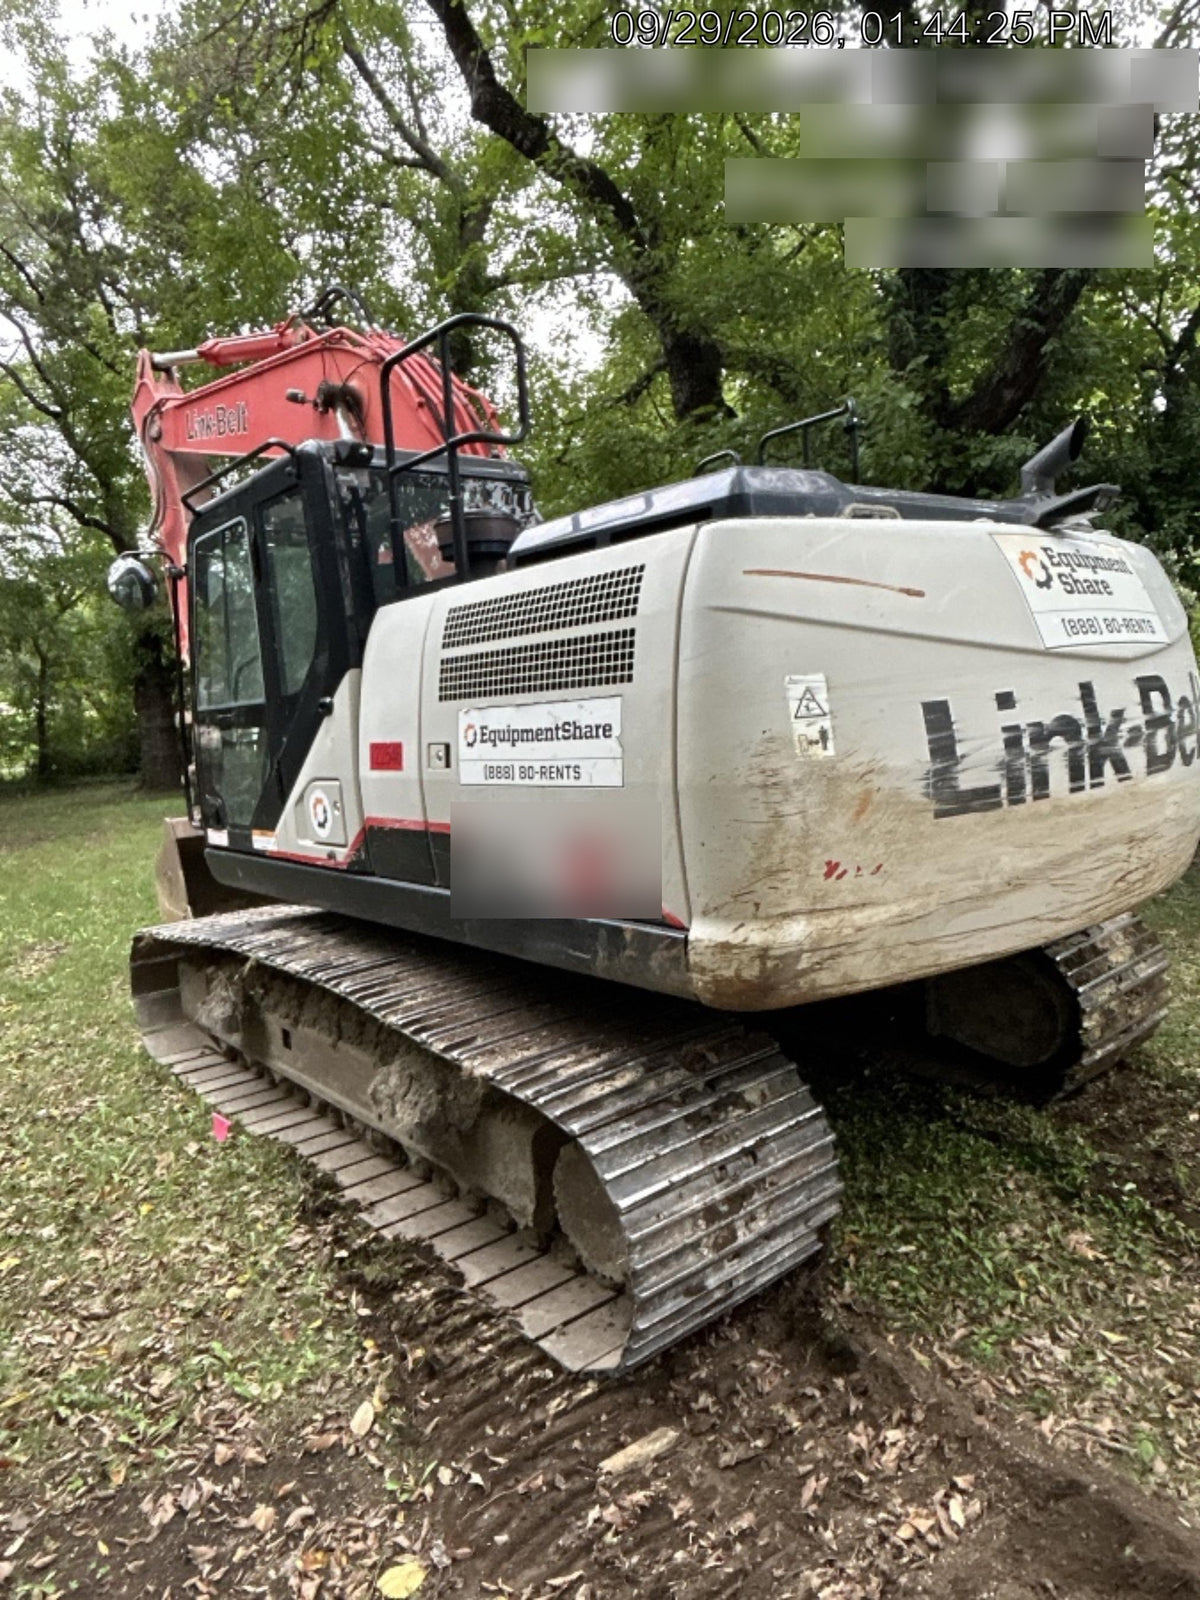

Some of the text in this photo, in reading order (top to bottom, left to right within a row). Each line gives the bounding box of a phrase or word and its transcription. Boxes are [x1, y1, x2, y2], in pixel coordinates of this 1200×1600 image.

[186, 402, 249, 441] Link-Belt
[1042, 547, 1133, 574] Equipment
[1058, 573, 1114, 596] Share
[1061, 617, 1157, 637] (888) 80-RENTS
[479, 721, 612, 747] EquipmentShare
[918, 671, 1200, 819] Link-Bel
[484, 764, 582, 781] (888) 80-RENTS
